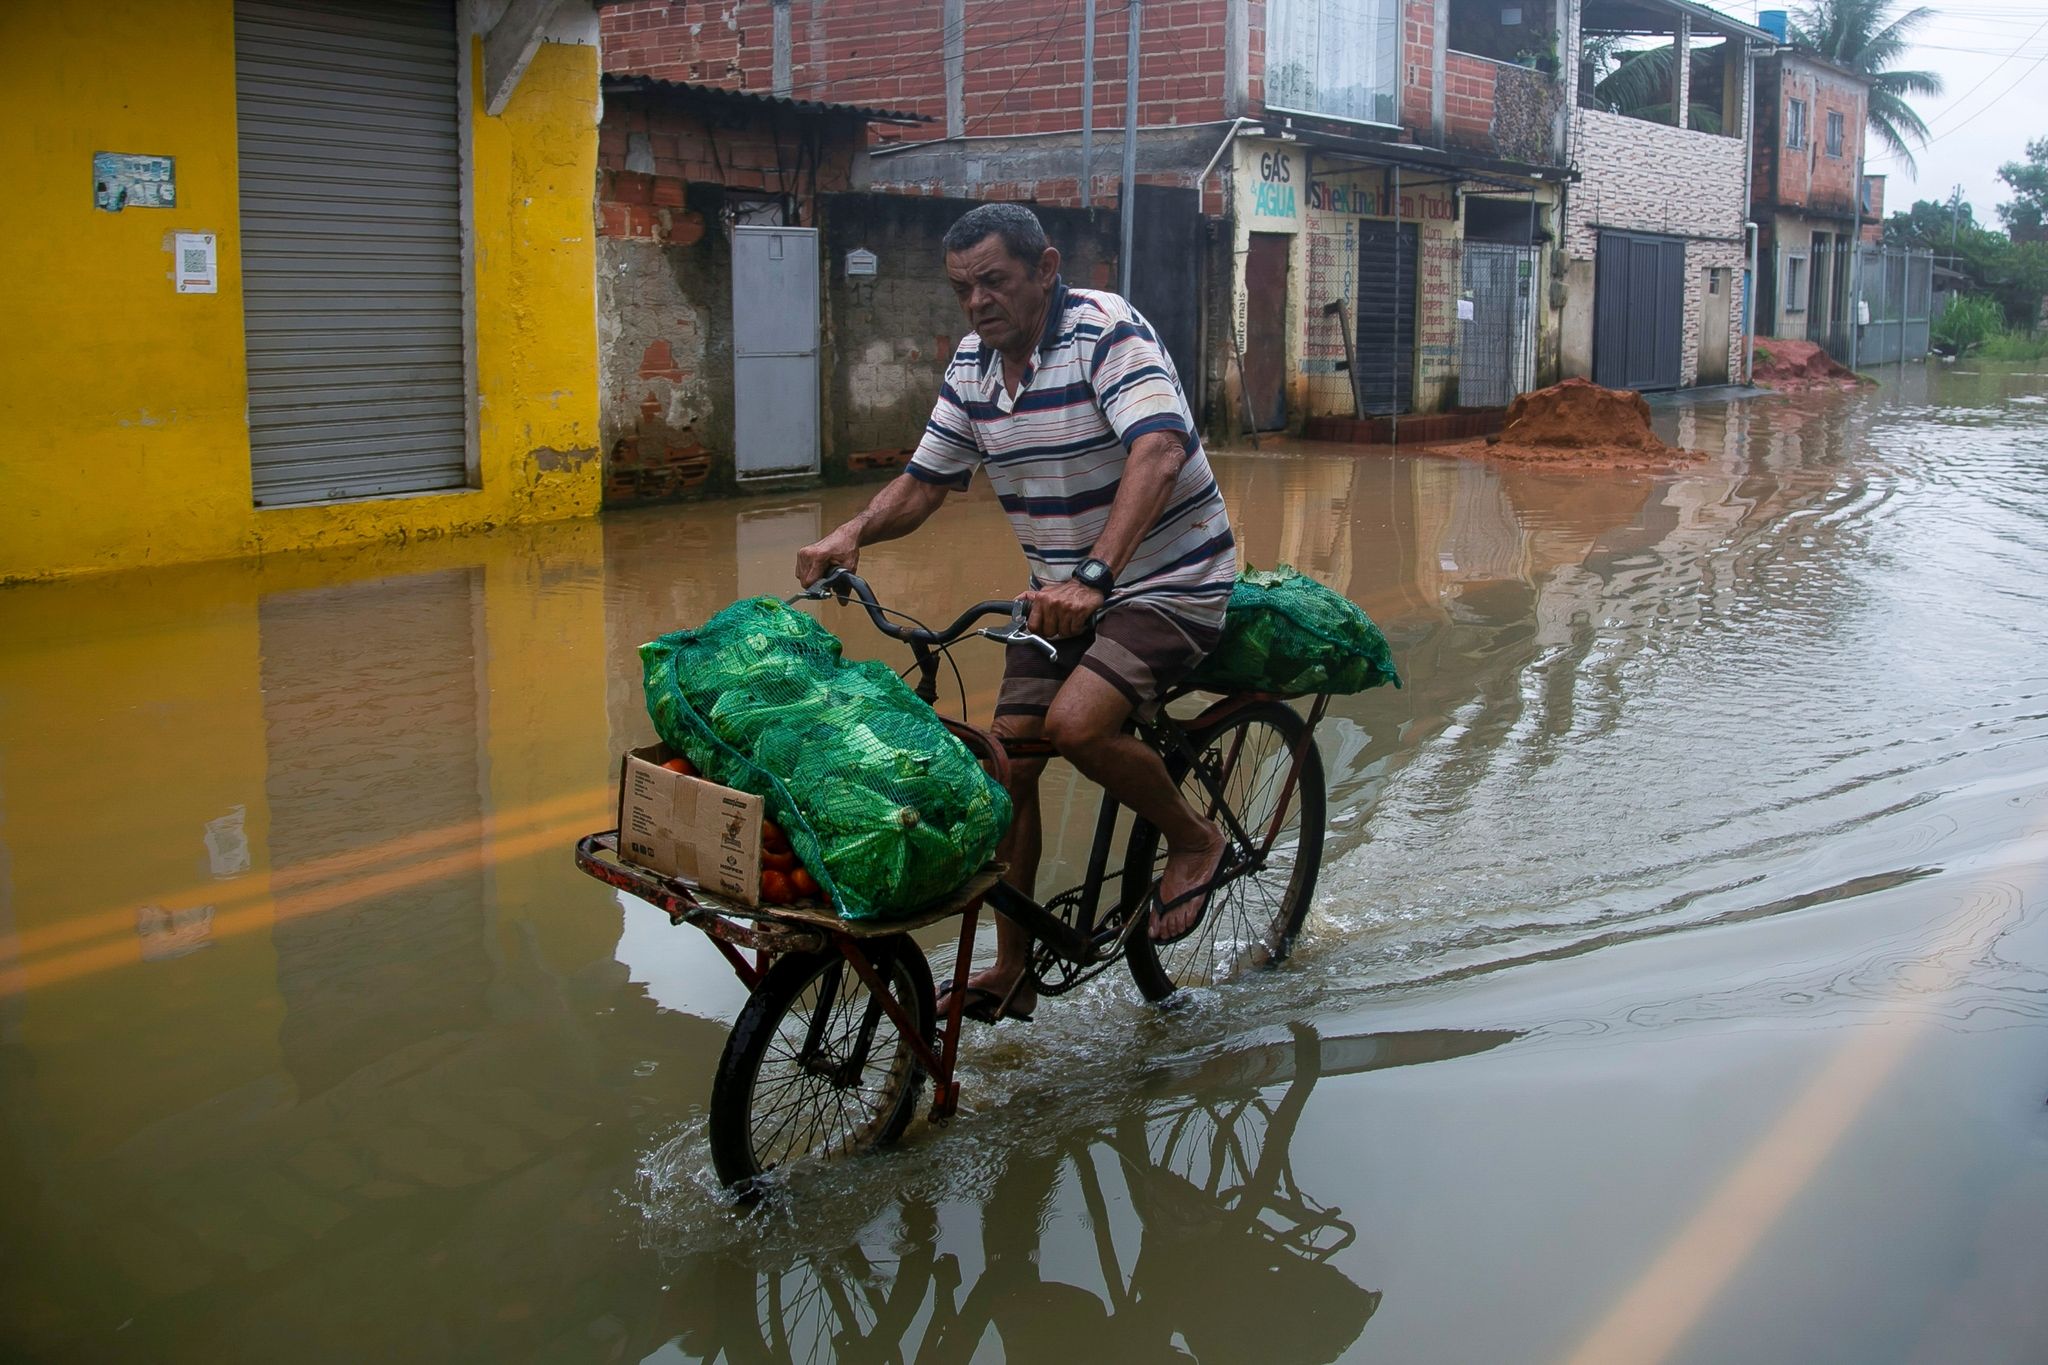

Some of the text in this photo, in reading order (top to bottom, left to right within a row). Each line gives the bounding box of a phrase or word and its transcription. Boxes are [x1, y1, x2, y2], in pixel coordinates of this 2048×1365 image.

[1260, 149, 1291, 183] GÁS
[1237, 291, 1246, 354] muito mais
